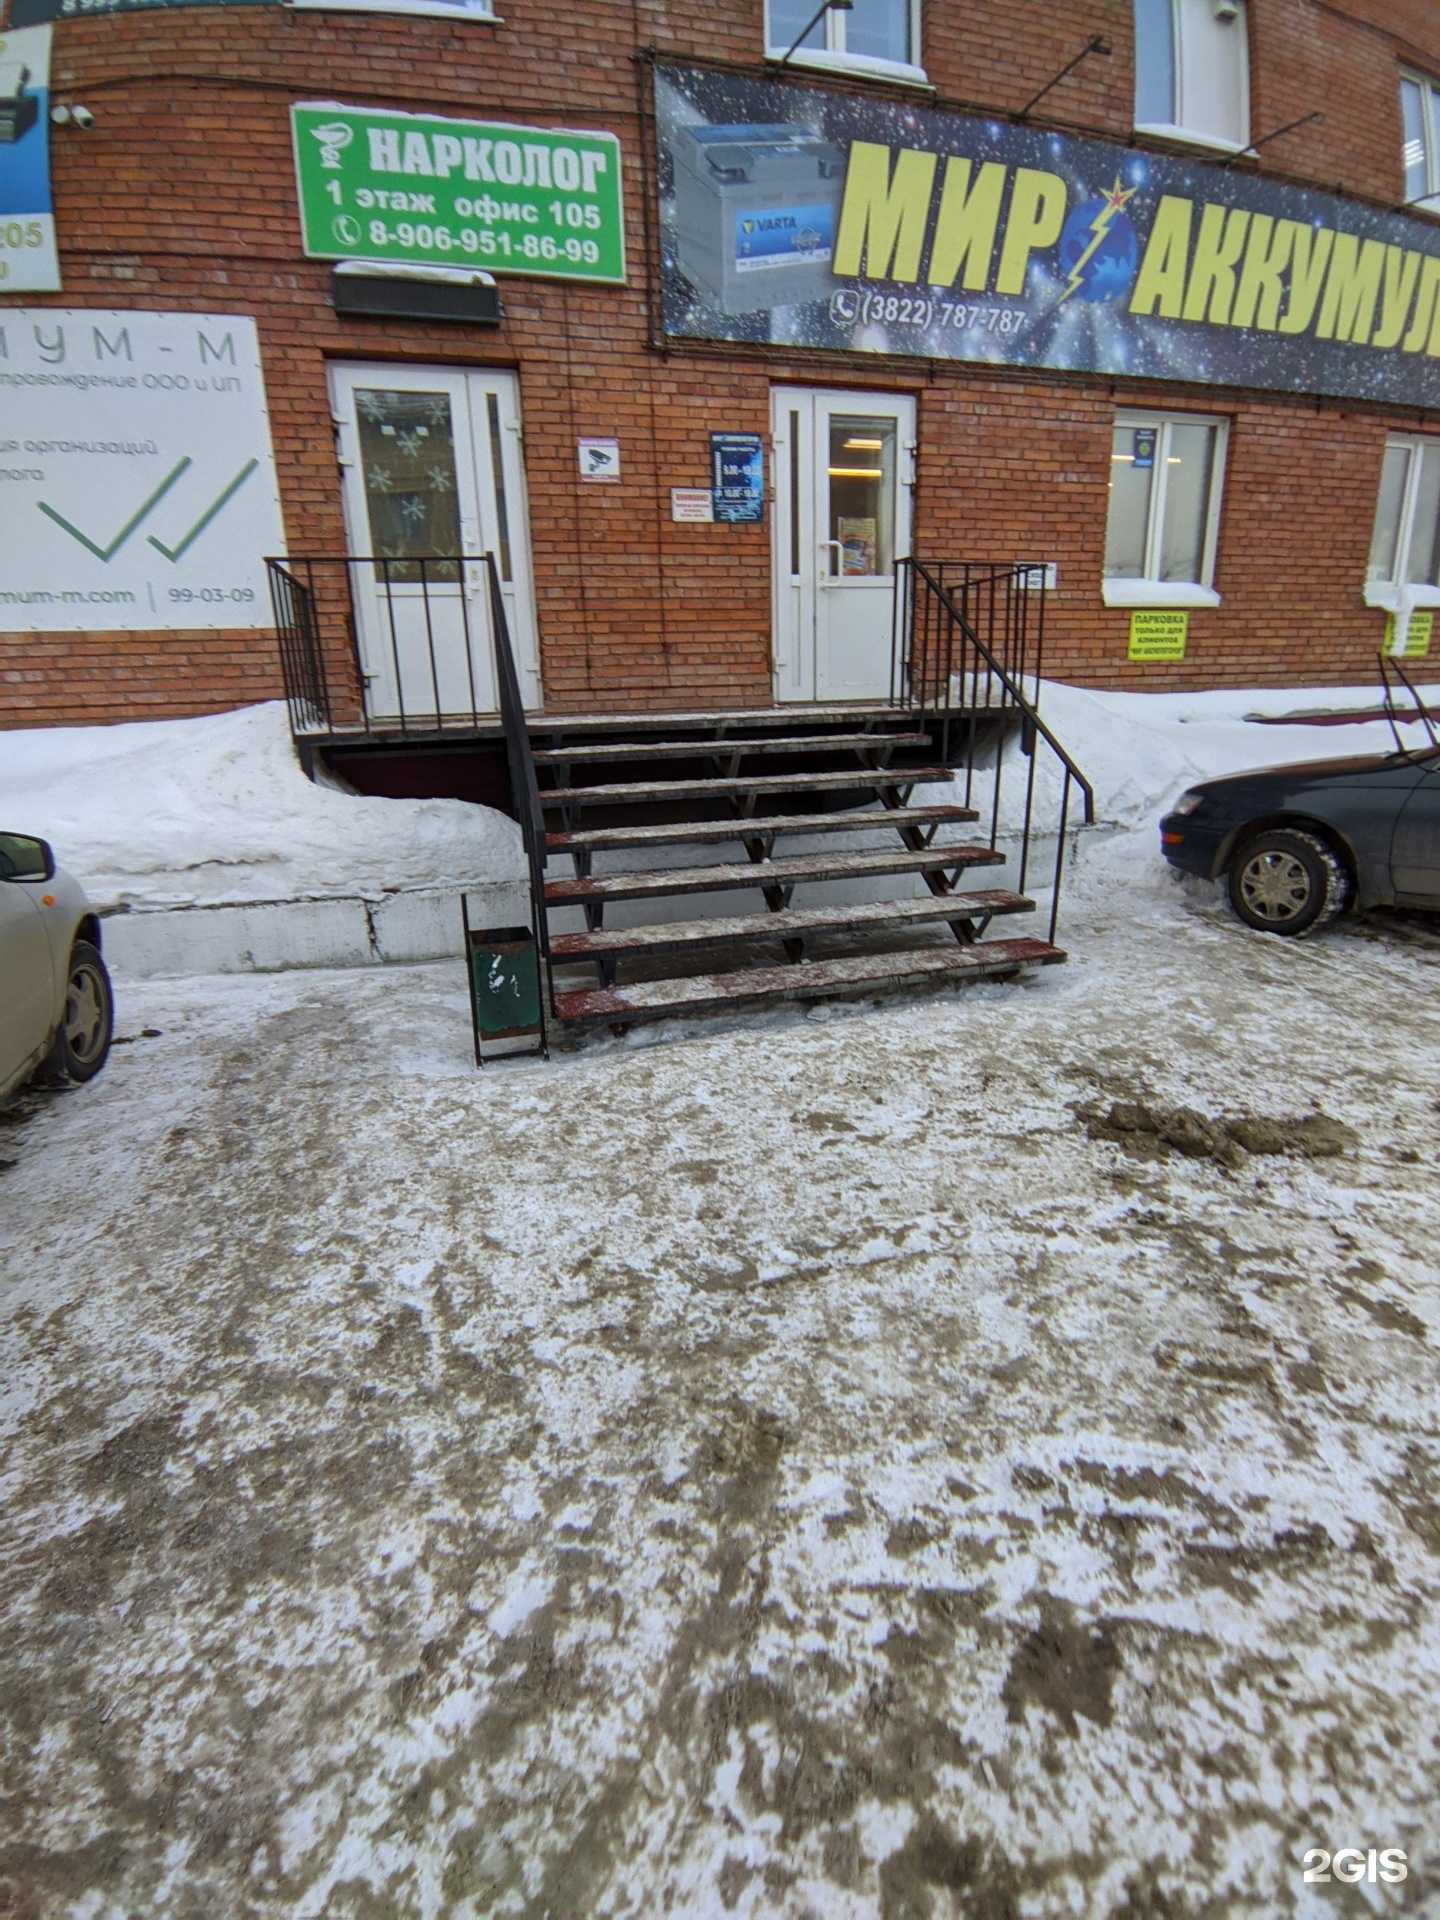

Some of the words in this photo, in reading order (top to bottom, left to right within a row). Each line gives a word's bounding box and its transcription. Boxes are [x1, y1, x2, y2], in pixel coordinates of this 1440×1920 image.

[366, 127, 607, 194] НАРКОЛОГ
[326, 179, 342, 205] 1
[355, 187, 437, 214] этаж
[454, 194, 539, 225] офис
[548, 201, 602, 230] 105
[832, 139, 1067, 296] МИР
[0, 221, 43, 249] 05
[756, 215, 798, 233] VARTA
[368, 220, 600, 264] 8-906-951-86-99
[862, 292, 933, 330] (3822)
[940, 302, 1026, 334] 787-787
[142, 374, 190, 391] ООО
[23, 439, 159, 456] организаций
[167, 587, 255, 603] 99-03-09
